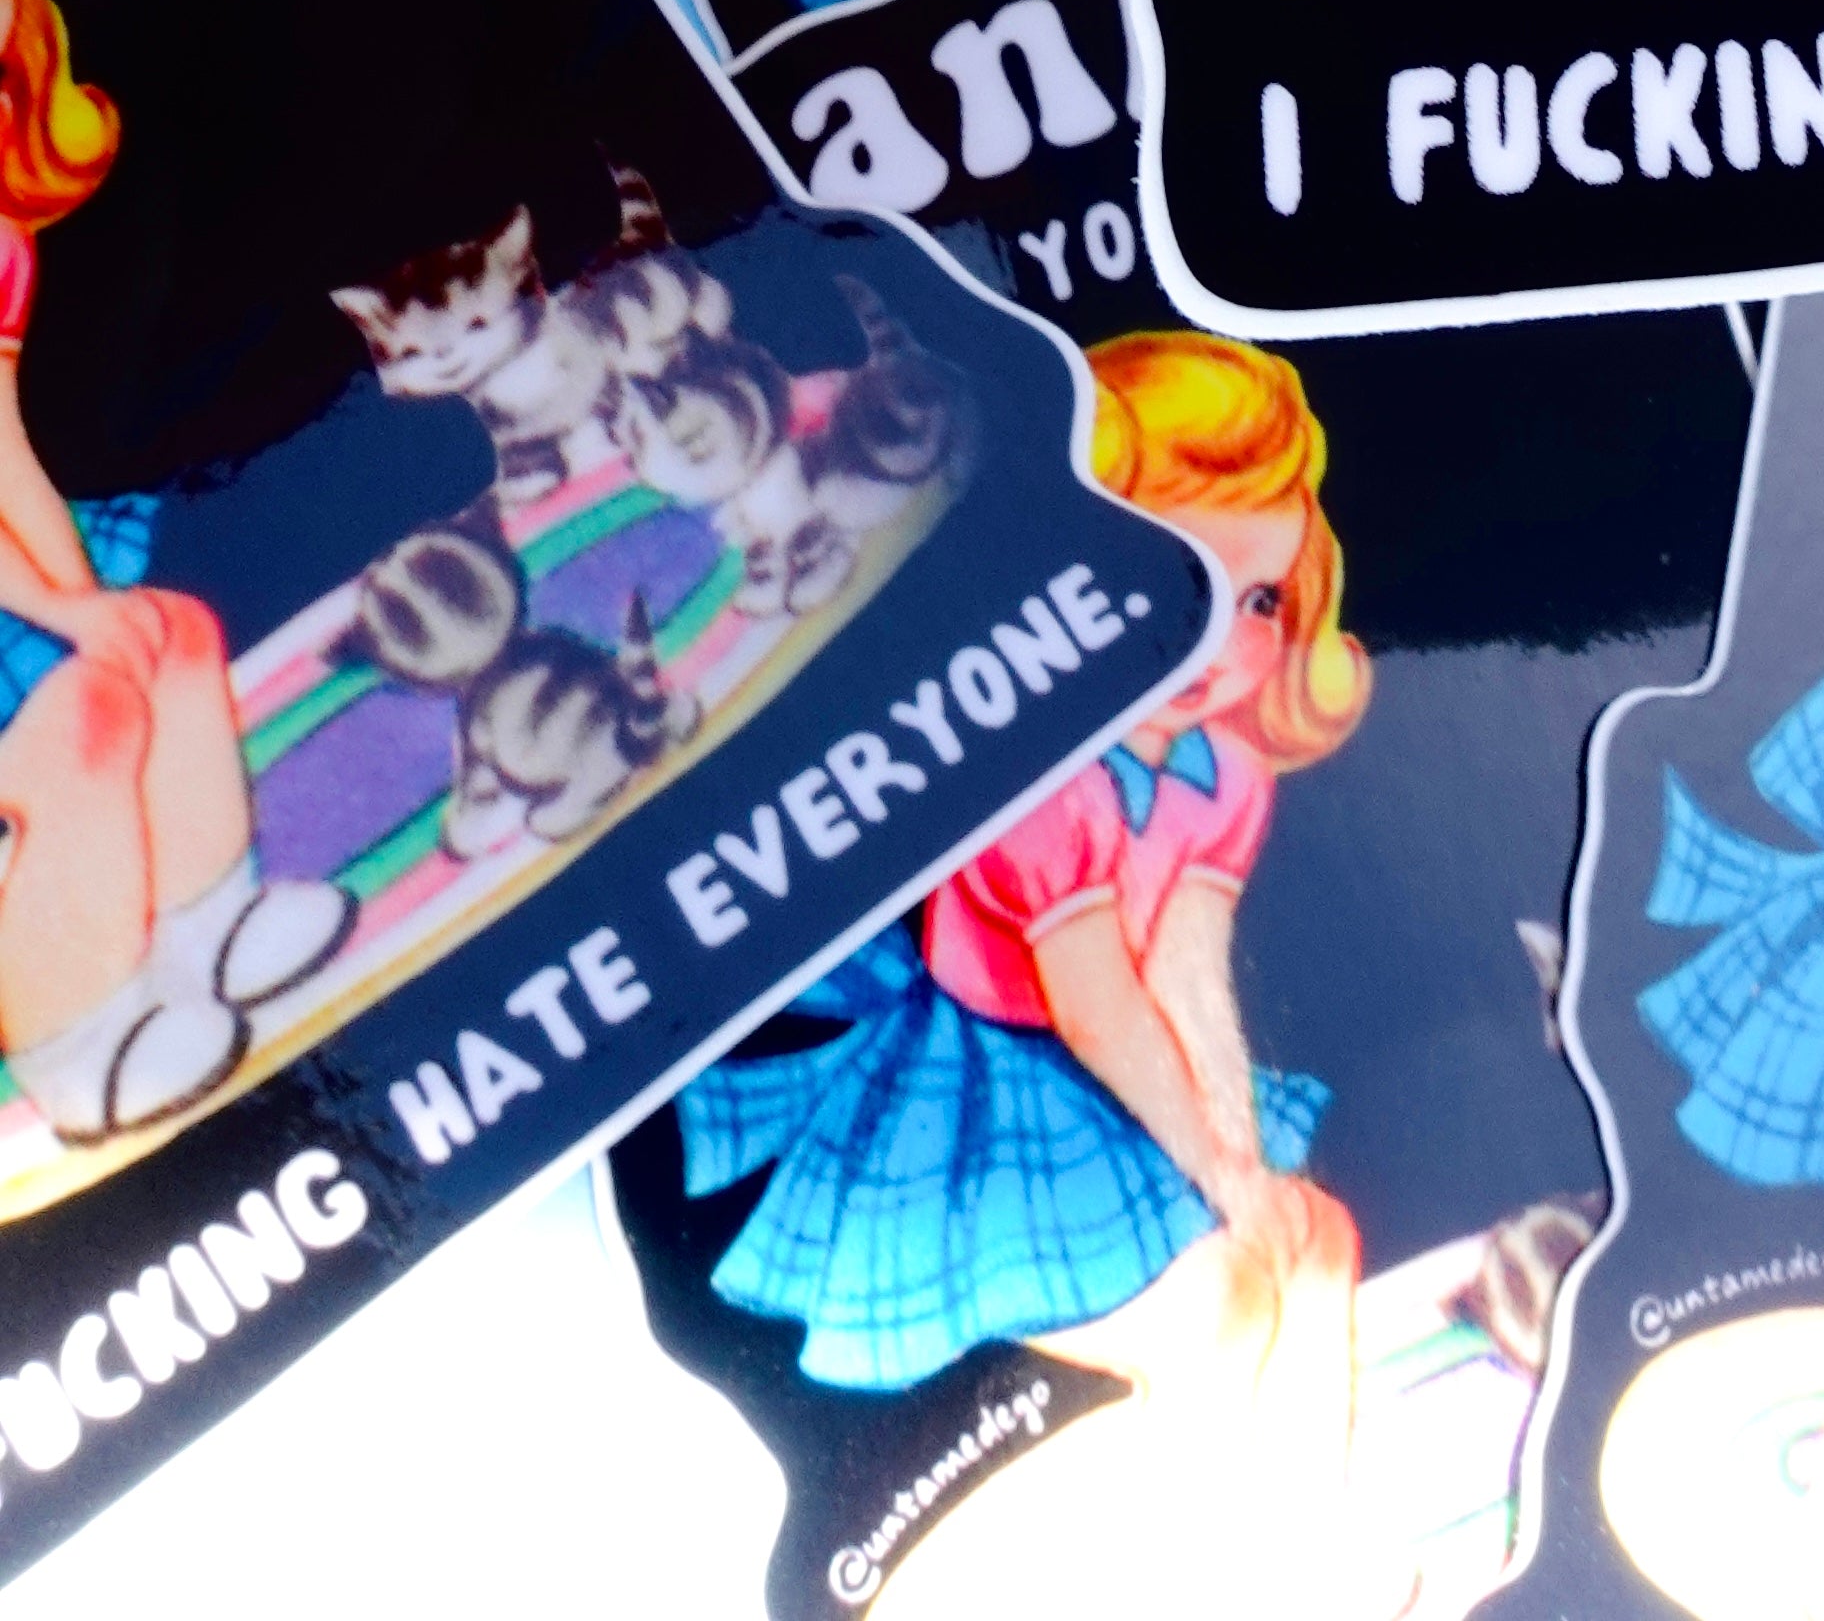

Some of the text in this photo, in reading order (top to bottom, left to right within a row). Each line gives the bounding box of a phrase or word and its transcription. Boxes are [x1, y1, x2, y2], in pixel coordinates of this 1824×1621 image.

[1261, 81, 1303, 217] I
[0, 561, 1152, 1475] UCKING HATE EVERYONE.
[828, 1377, 1050, 1605] @untamedego
